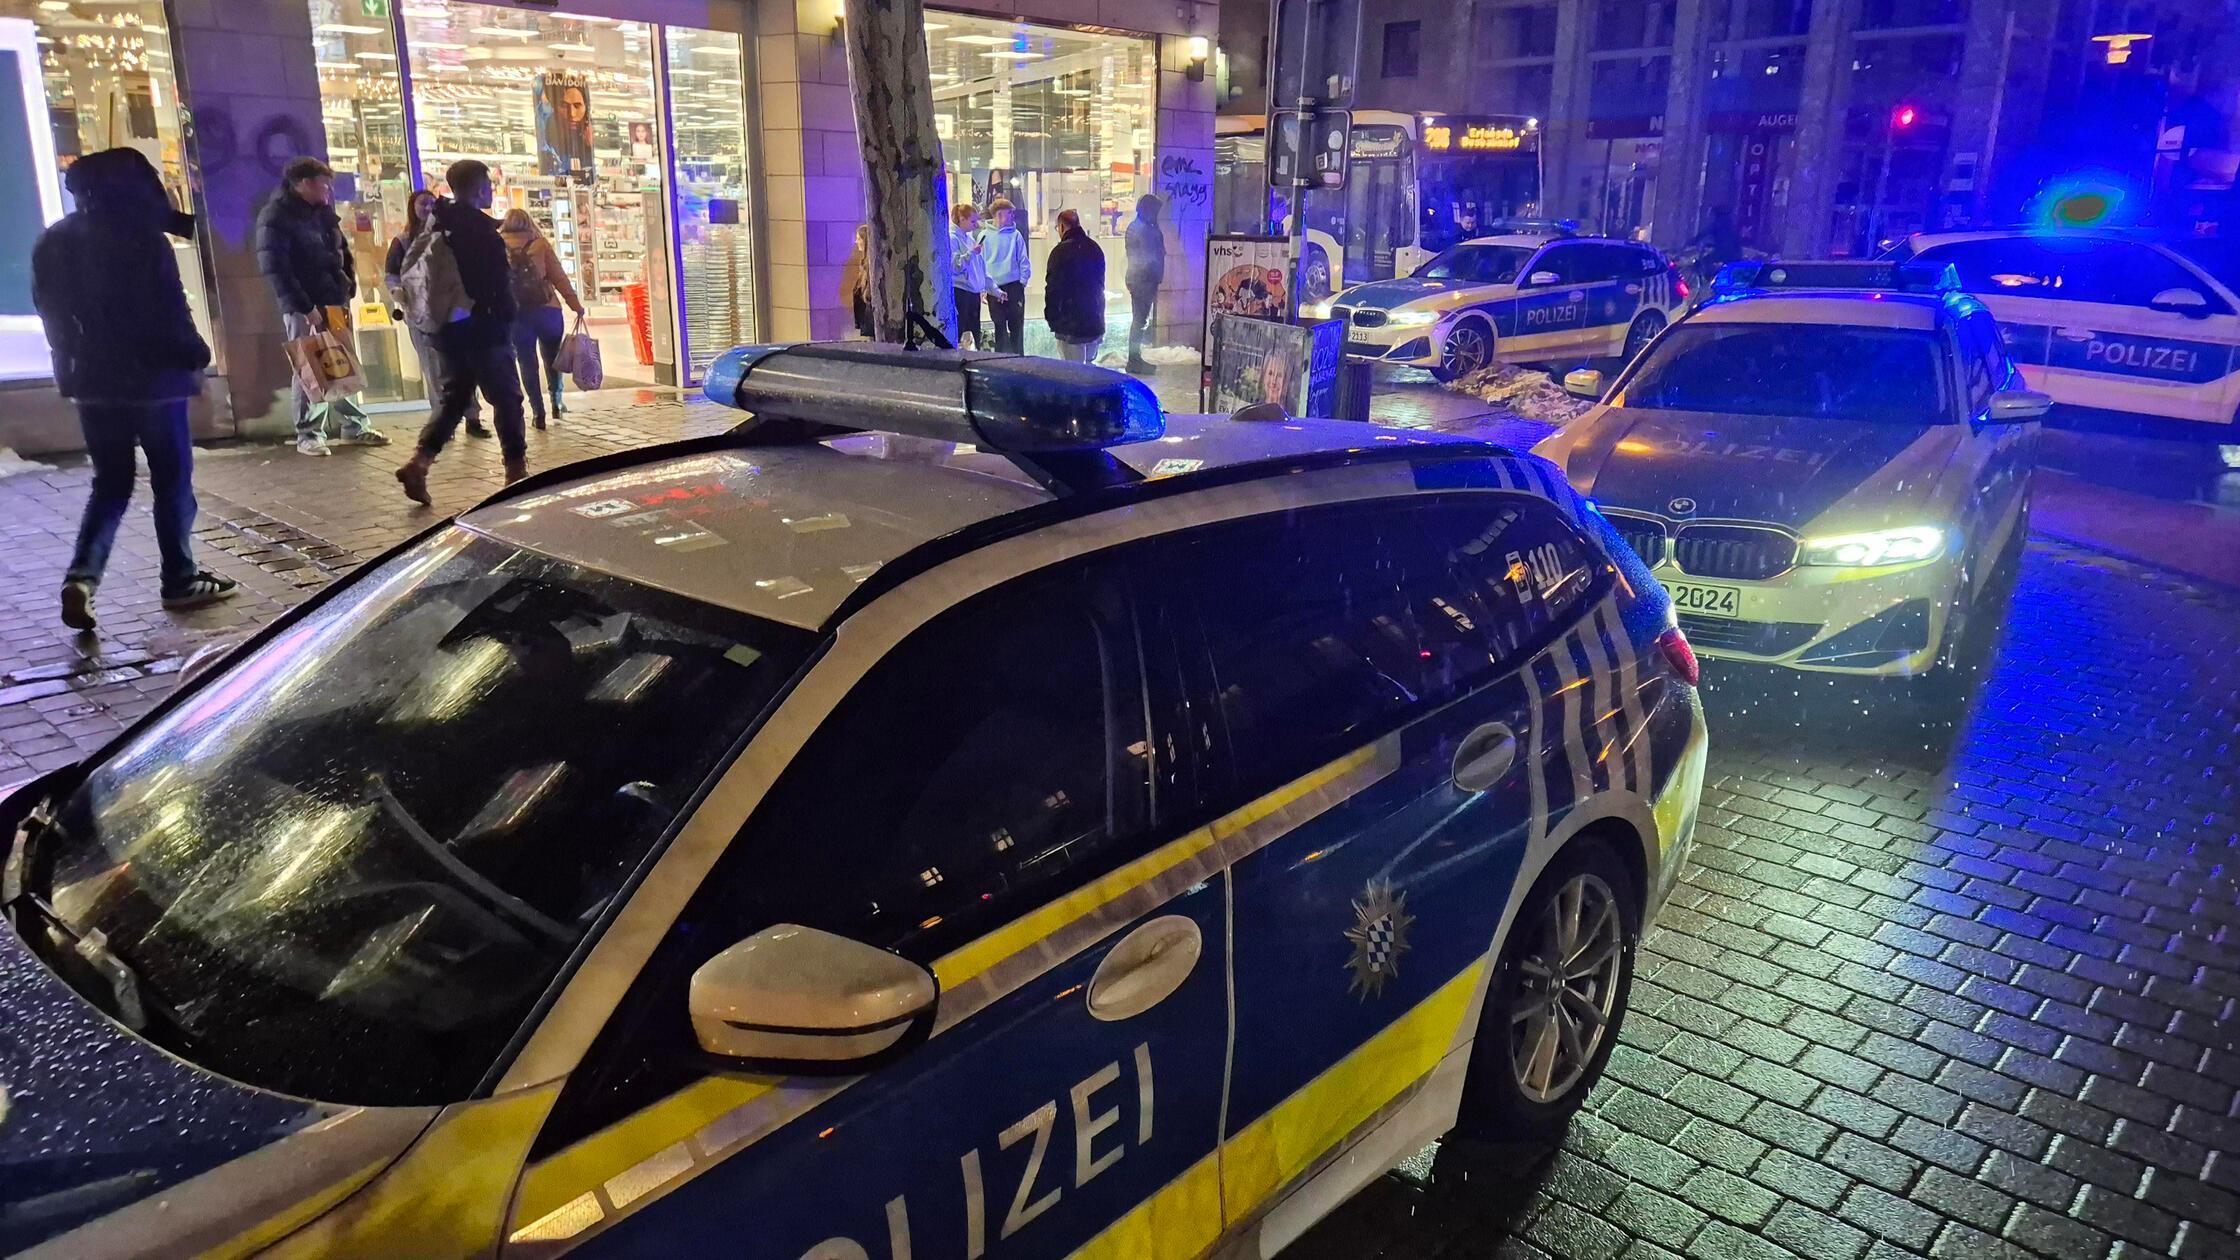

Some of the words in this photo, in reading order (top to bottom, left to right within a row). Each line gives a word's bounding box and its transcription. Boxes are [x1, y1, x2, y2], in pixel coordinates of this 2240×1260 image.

[1213, 245, 1233, 257] vhs
[1526, 304, 1578, 326] POLIZEI
[1351, 330, 1369, 342] 2113
[2086, 340, 2198, 373] POLIZEI
[1674, 585, 1735, 613] 2024
